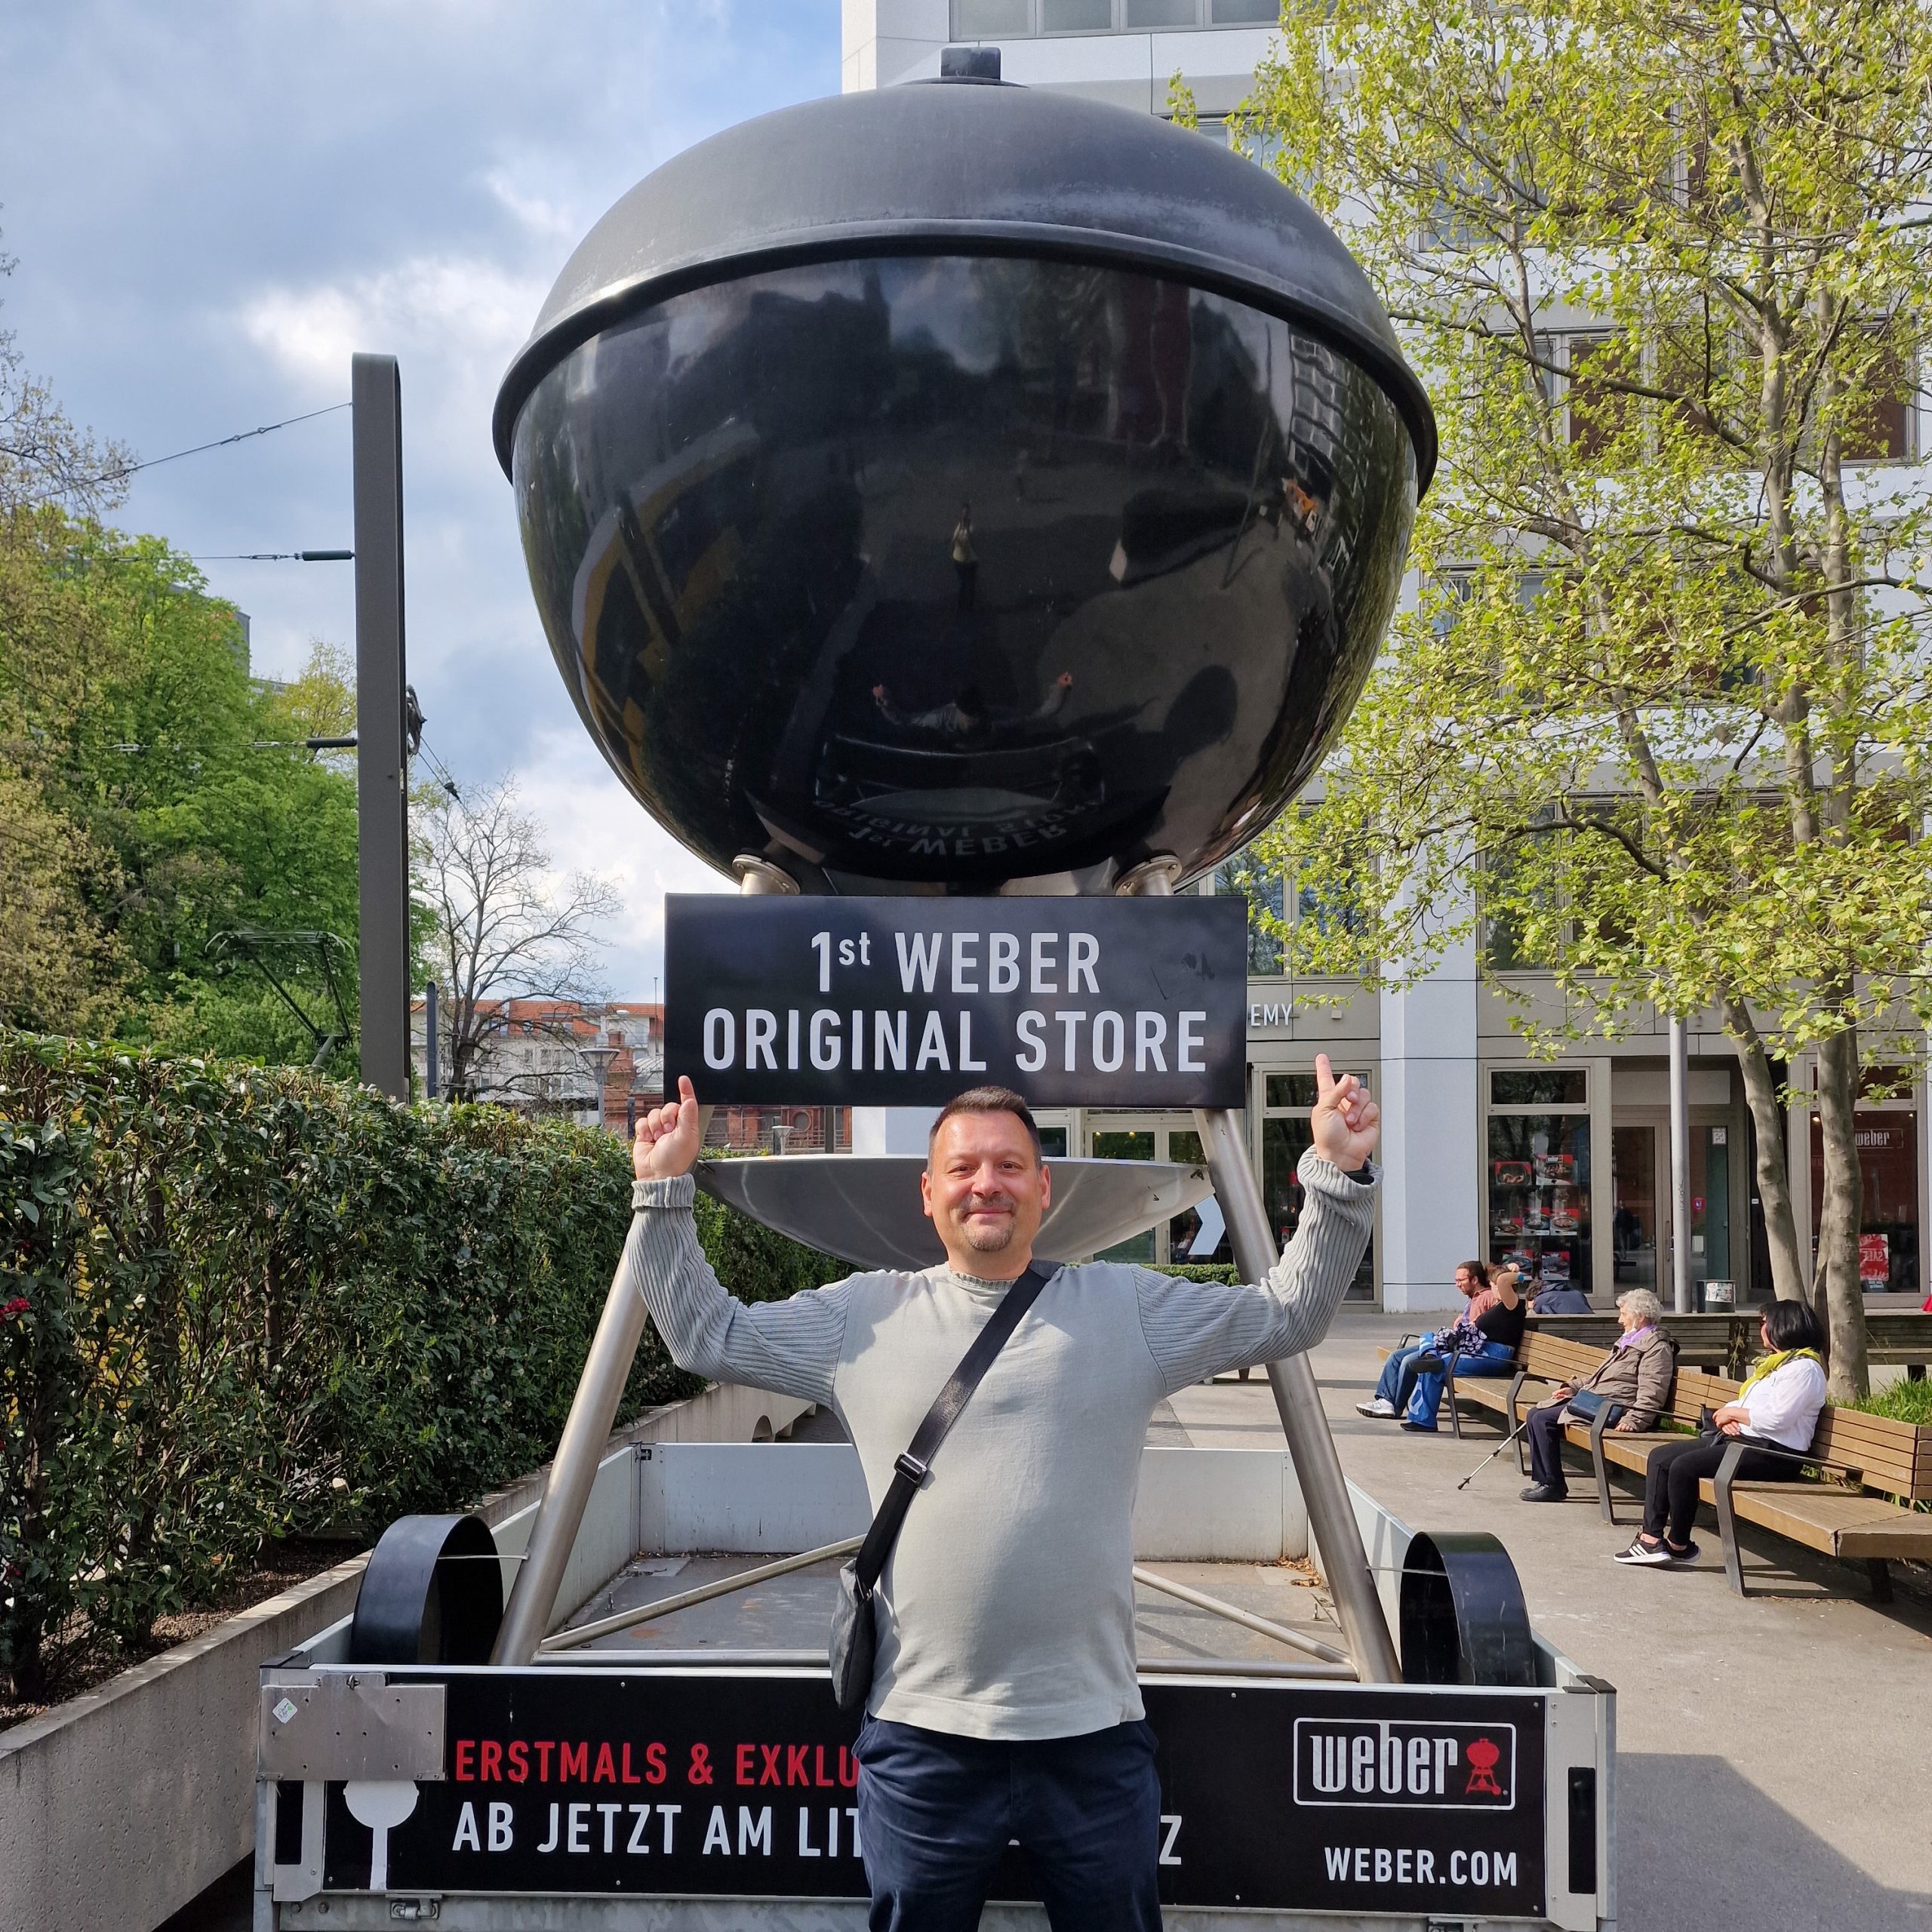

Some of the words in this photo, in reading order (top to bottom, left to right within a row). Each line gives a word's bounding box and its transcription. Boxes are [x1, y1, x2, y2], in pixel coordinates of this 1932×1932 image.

[811, 931, 871, 992] 1st
[894, 932, 1100, 994] WEBER
[703, 1008, 986, 1071] ORIGINAL
[1015, 1010, 1207, 1072] STORE
[1251, 1003, 1293, 1026] EMY
[1855, 1129, 1890, 1146] weber
[456, 1740, 666, 1784] ERSTMALS
[688, 1743, 713, 1785] &
[736, 1744, 860, 1787] EXKLU
[1309, 1731, 1458, 1795] weber
[452, 1801, 513, 1851] AB
[537, 1803, 681, 1854] JETZT
[702, 1805, 772, 1856] AM
[798, 1807, 862, 1857] LIT
[1158, 1815, 1183, 1865] Z
[1324, 1847, 1517, 1887] WEBER.COM
